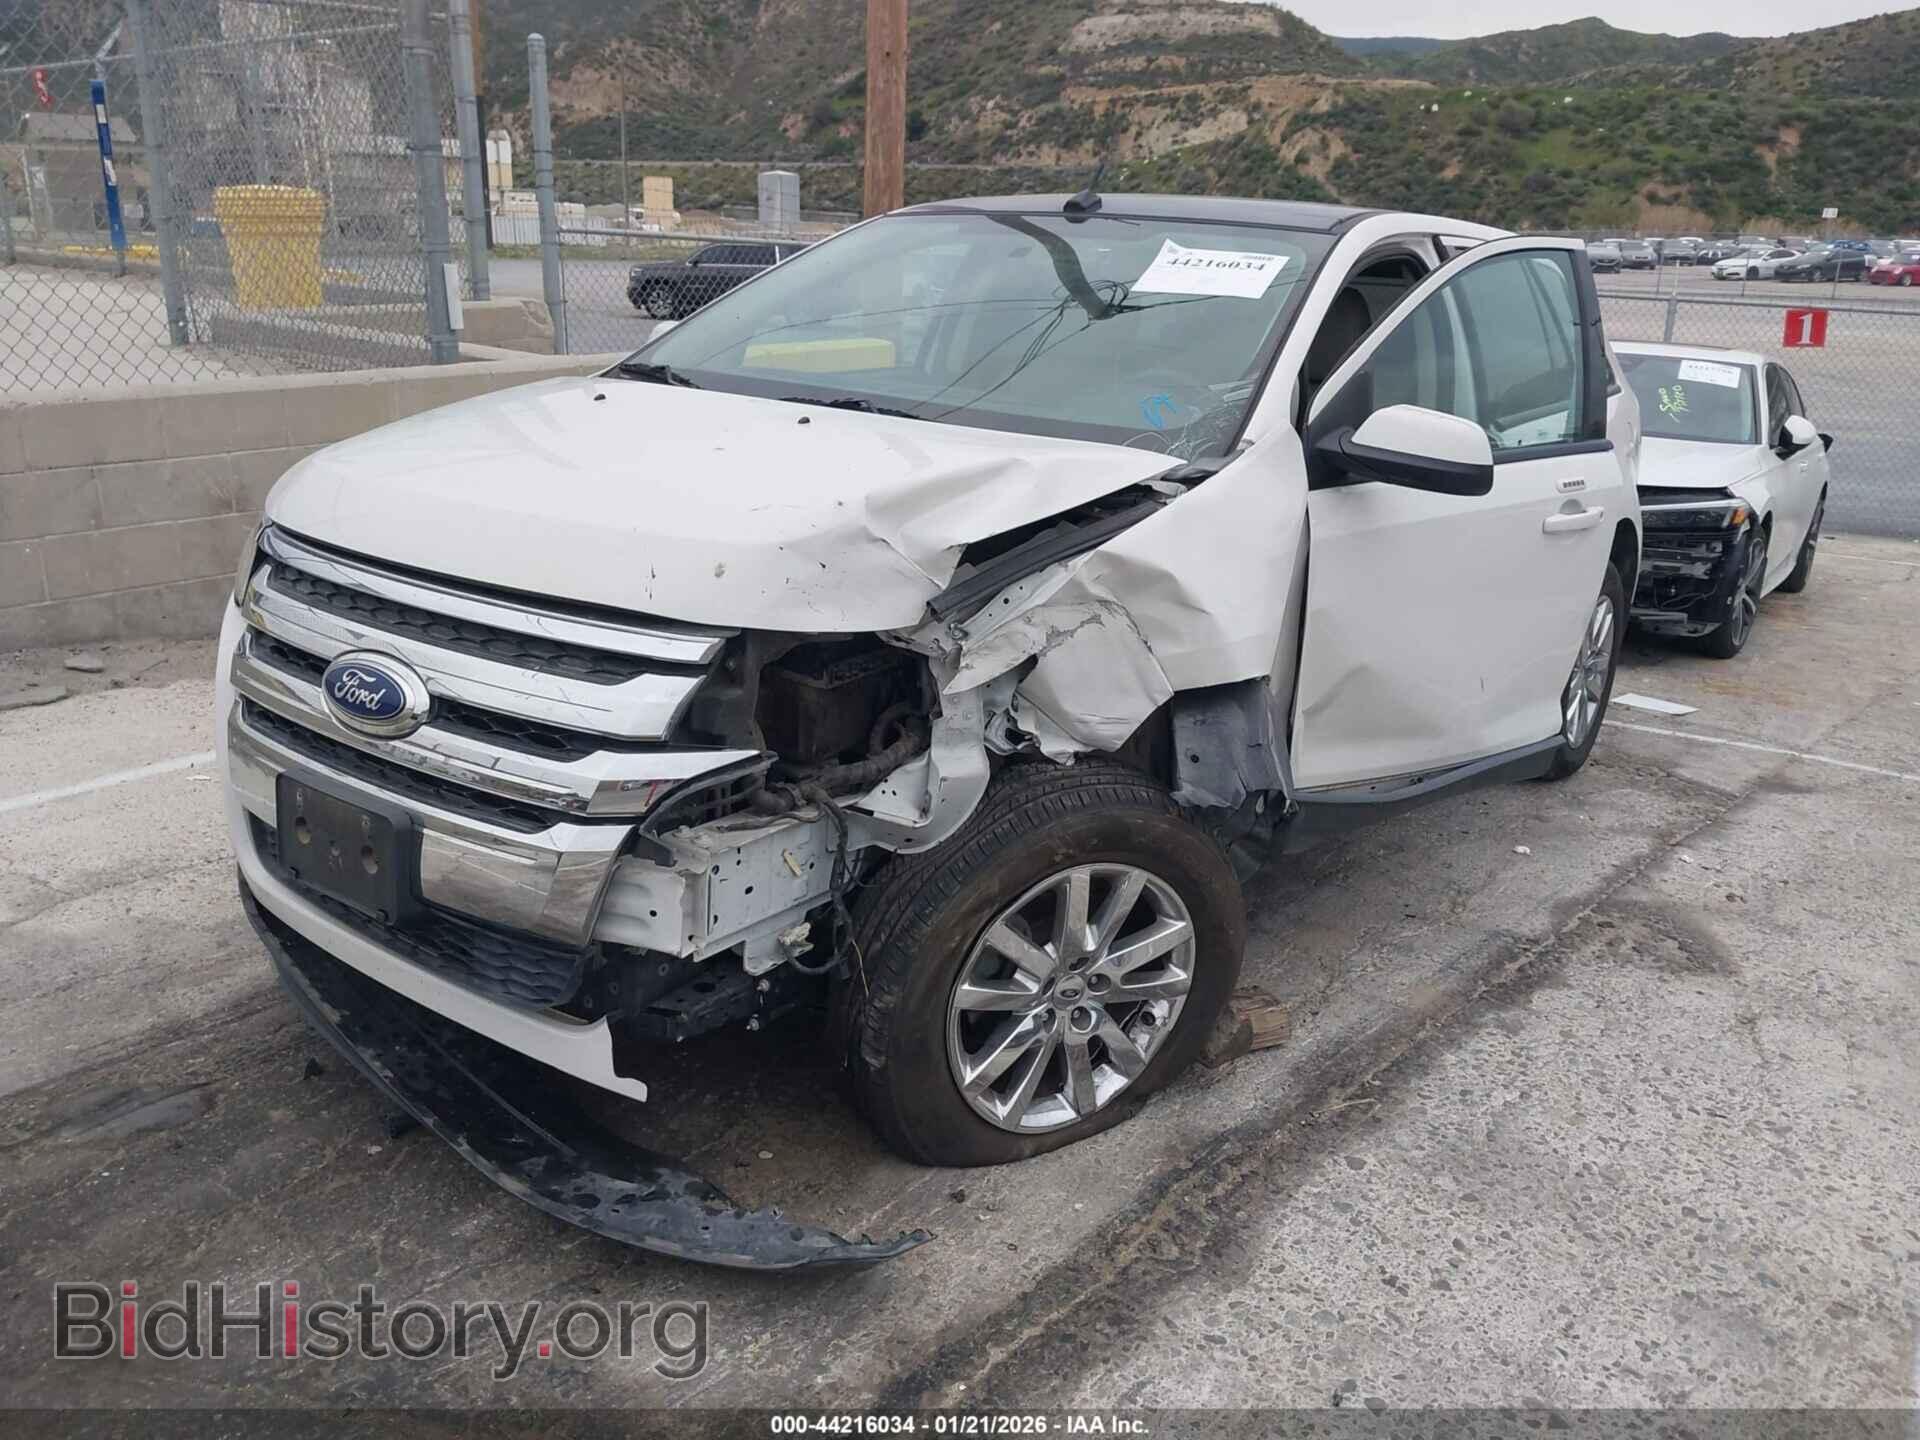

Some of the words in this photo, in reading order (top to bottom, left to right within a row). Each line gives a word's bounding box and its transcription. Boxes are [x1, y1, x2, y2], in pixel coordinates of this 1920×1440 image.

[1166, 256, 1267, 272] 44216034
[1797, 312, 1814, 345] 1
[334, 668, 387, 711] Ford
